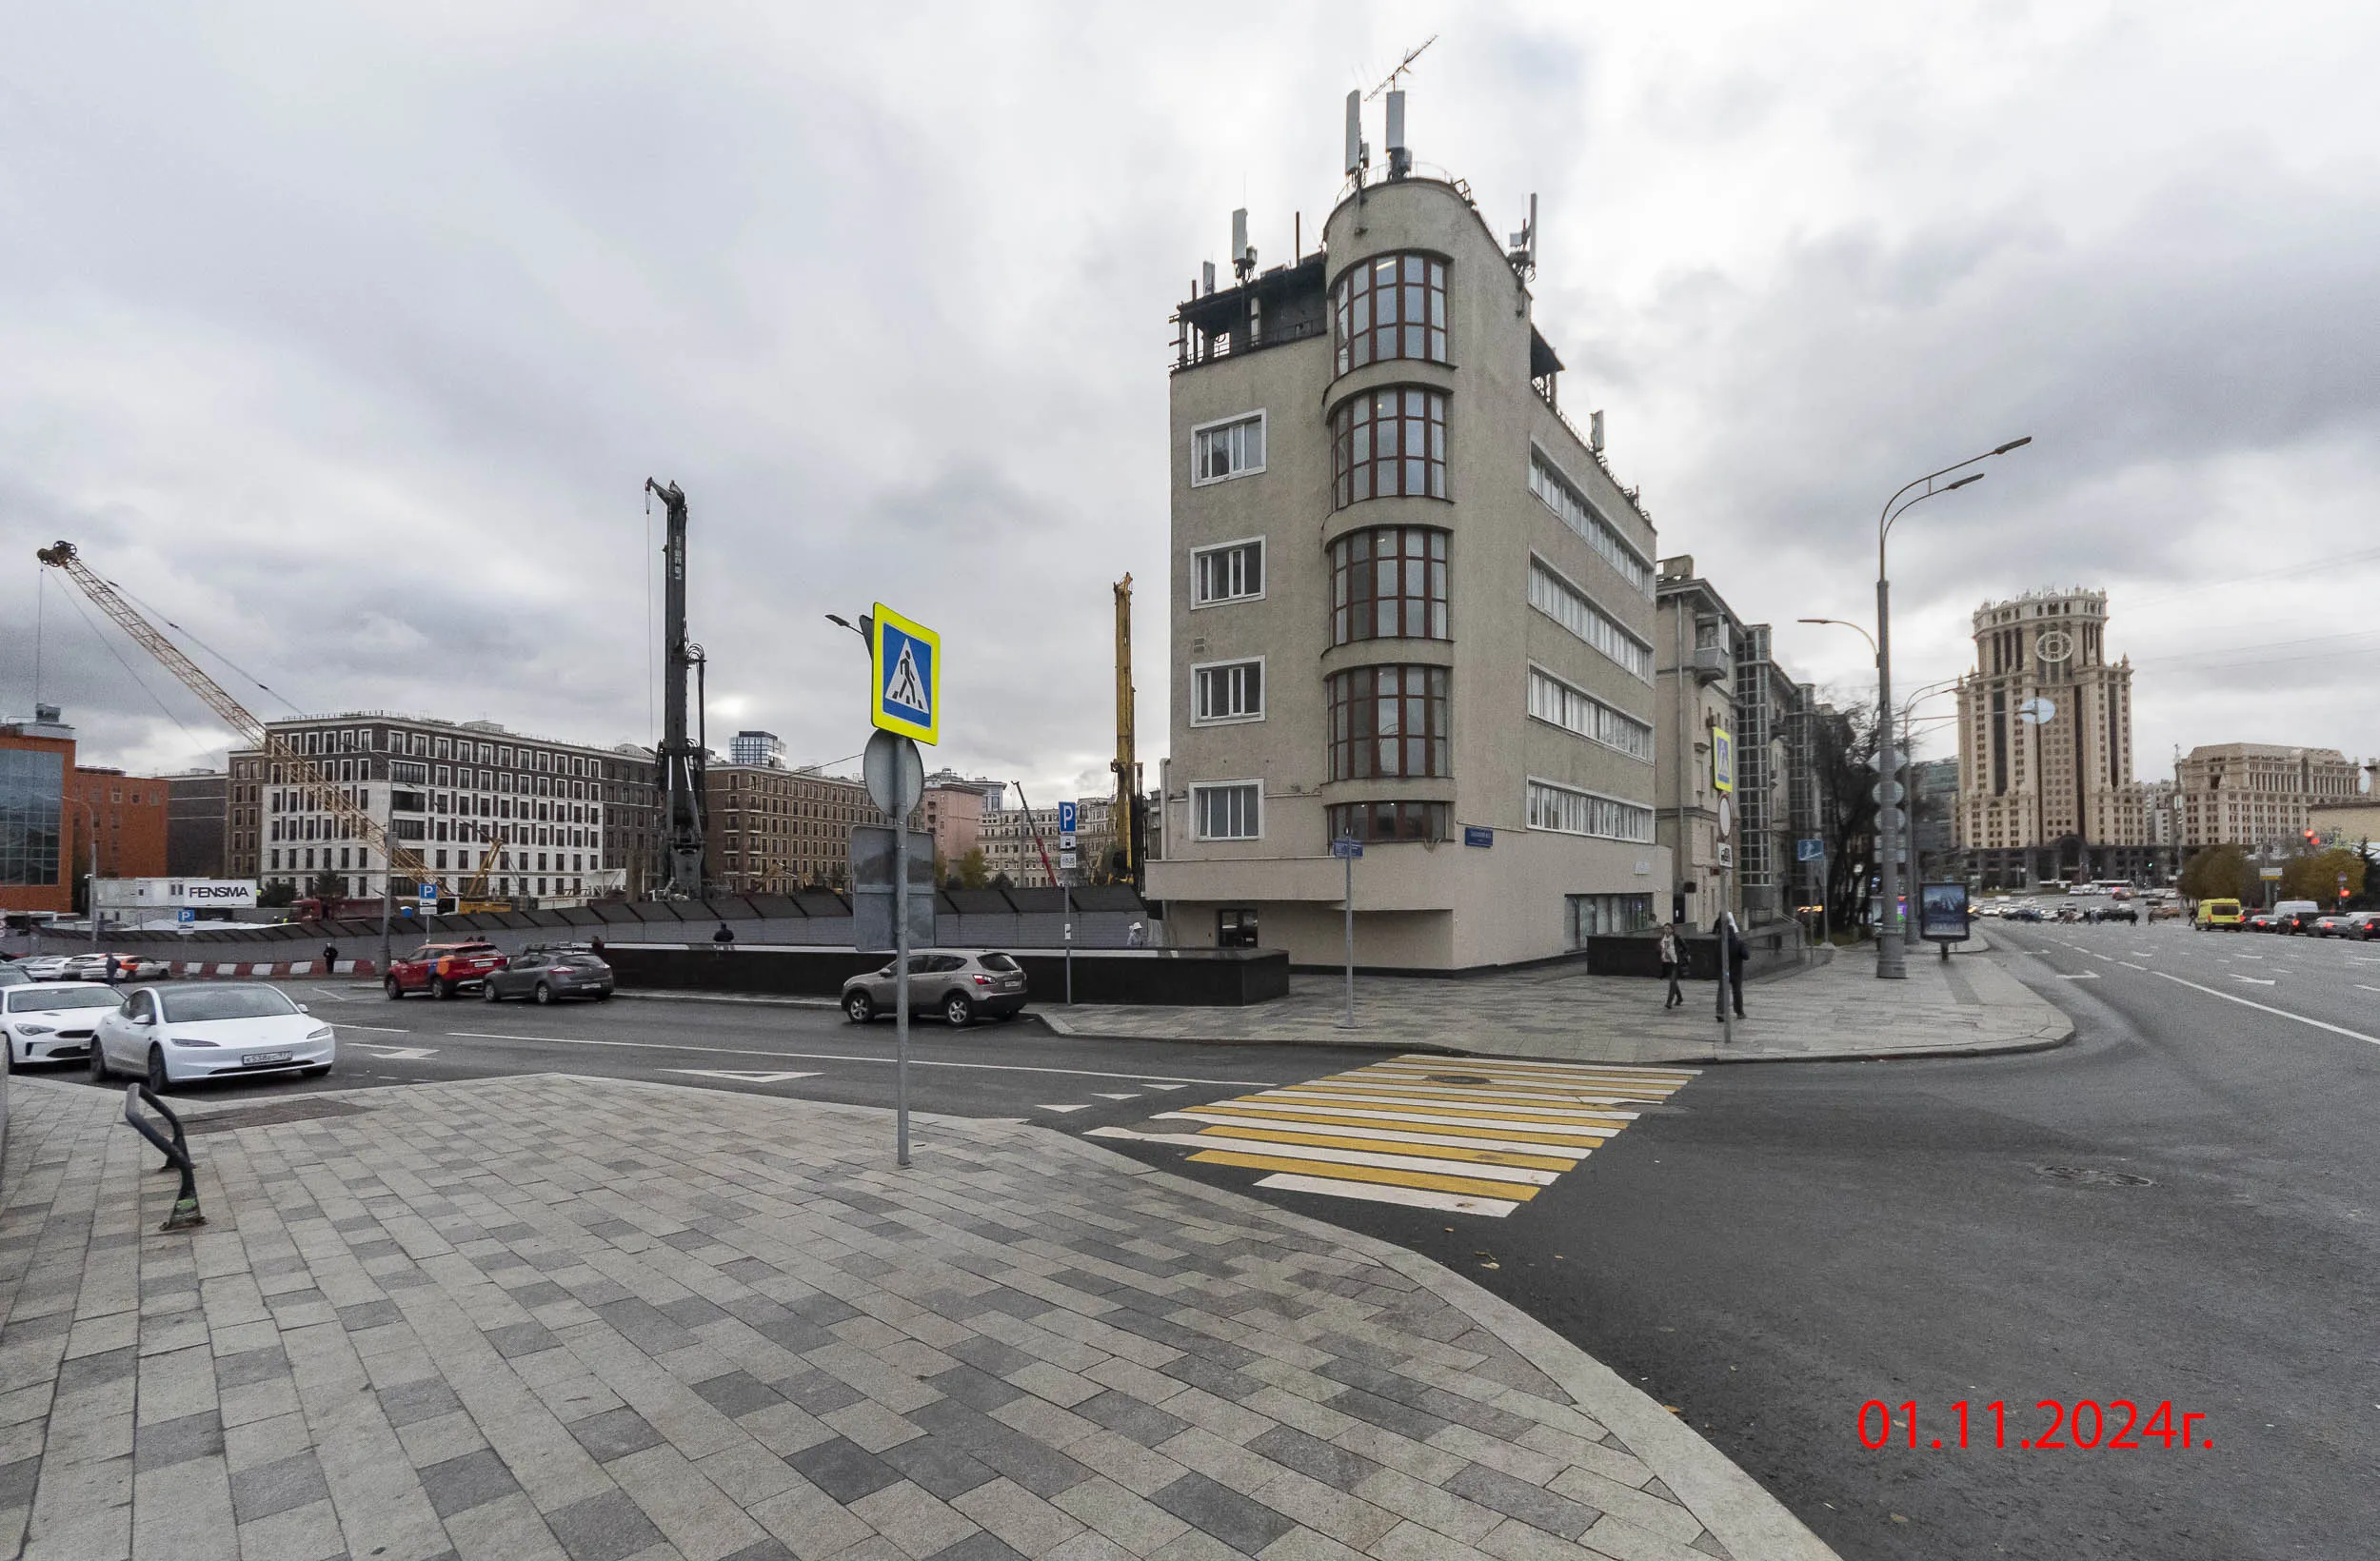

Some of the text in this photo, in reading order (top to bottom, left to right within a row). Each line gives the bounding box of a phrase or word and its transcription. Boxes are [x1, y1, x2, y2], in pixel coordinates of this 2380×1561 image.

[1063, 805, 1073, 829] P
[189, 886, 249, 899] FENSMA
[425, 885, 433, 898] P
[182, 911, 190, 921] P
